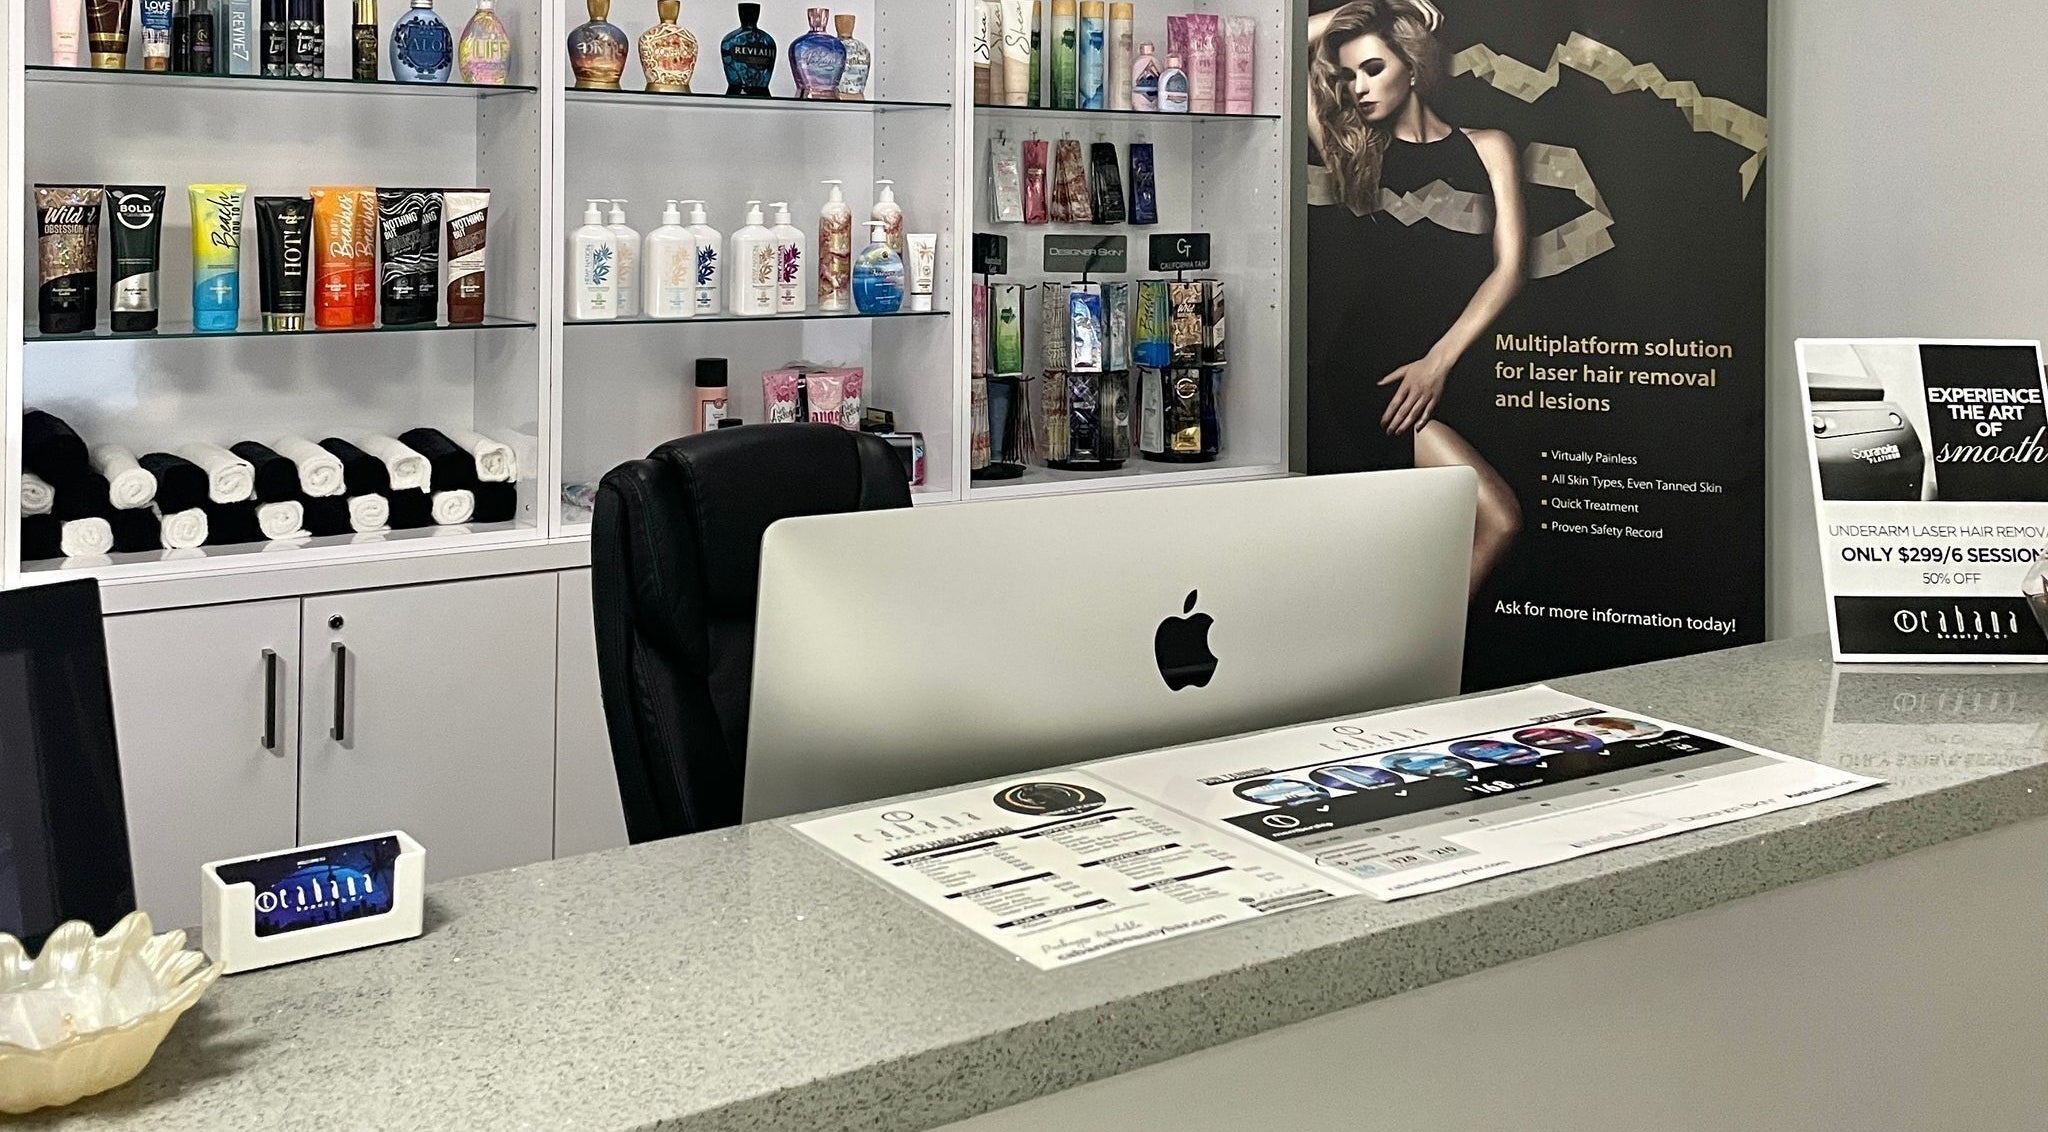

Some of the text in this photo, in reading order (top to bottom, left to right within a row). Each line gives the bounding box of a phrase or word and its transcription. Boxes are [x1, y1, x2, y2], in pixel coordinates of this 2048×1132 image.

[144, 1, 171, 11] LOVE
[232, 11, 249, 61] REVIVE7
[44, 206, 83, 224] Wild
[119, 204, 152, 213] BOLD
[231, 194, 240, 236] YOU TO IT
[44, 225, 84, 234] OBSESSION
[207, 191, 240, 251] Beach
[330, 194, 354, 259] Beaches
[355, 193, 375, 258] Beaches
[382, 211, 418, 231] NOTHING
[451, 211, 485, 231] NOTHING
[383, 230, 398, 240] BUT
[452, 229, 467, 240] BUT
[283, 230, 302, 277] HOT!
[1160, 260, 1193, 270] CALIFORNIA
[1495, 334, 1733, 359] Multiplatform solution
[1495, 361, 1716, 387] for laser hair removal
[1495, 390, 1611, 412] and lesions
[1927, 388, 2042, 404] EXPERIENCE
[811, 409, 841, 422] ange
[1947, 404, 2025, 421] THE ART
[1975, 422, 2003, 437] OF
[1935, 426, 2048, 464] smooth
[1551, 450, 1638, 466] Virtually Painless
[1551, 474, 1723, 494] All Skin Types, Even Tanned Skin
[1551, 498, 1639, 513] Quick Treatment
[1551, 521, 1663, 539] Proven Safety Record
[1829, 525, 2048, 538] UNDERARM LASER HAIR REMOV
[1841, 546, 2045, 565] ONLY $299/6 SESSION
[1922, 572, 1982, 585] 50% OFF
[1495, 600, 1736, 635] Ask for more information today!
